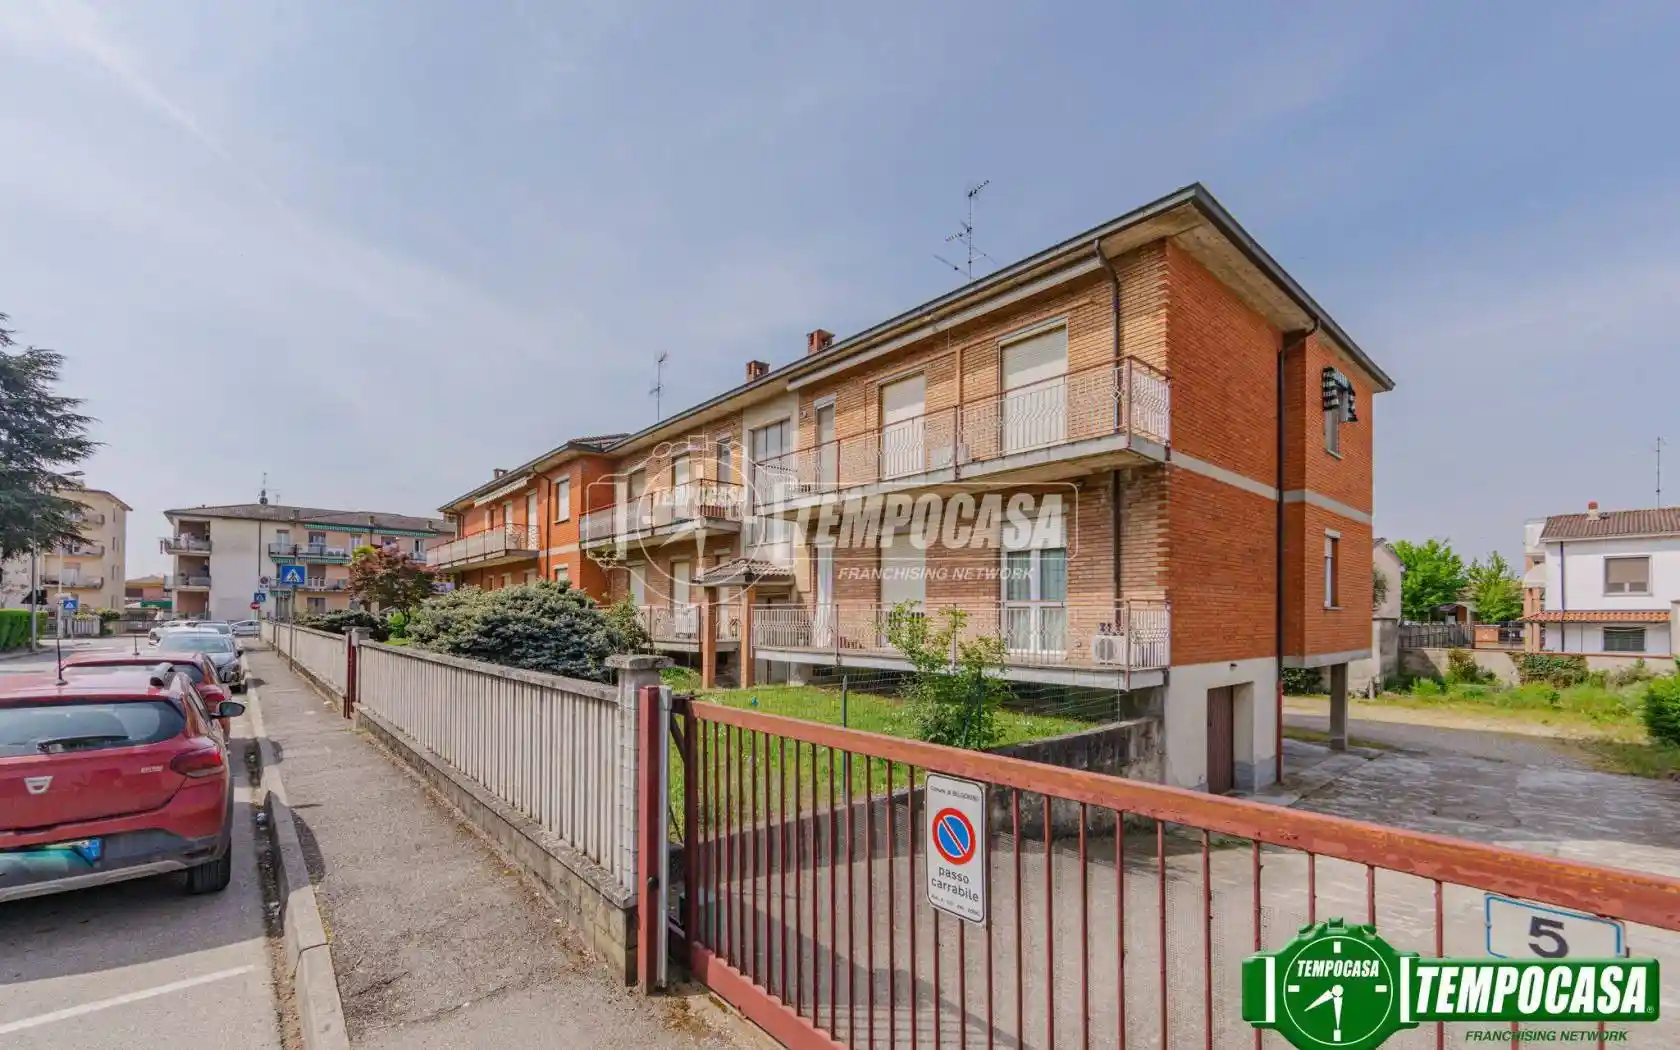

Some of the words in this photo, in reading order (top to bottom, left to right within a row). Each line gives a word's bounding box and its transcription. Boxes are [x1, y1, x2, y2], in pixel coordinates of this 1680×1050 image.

[939, 866, 970, 885] passo
[931, 877, 979, 903] carrabile
[1528, 915, 1570, 959] 5
